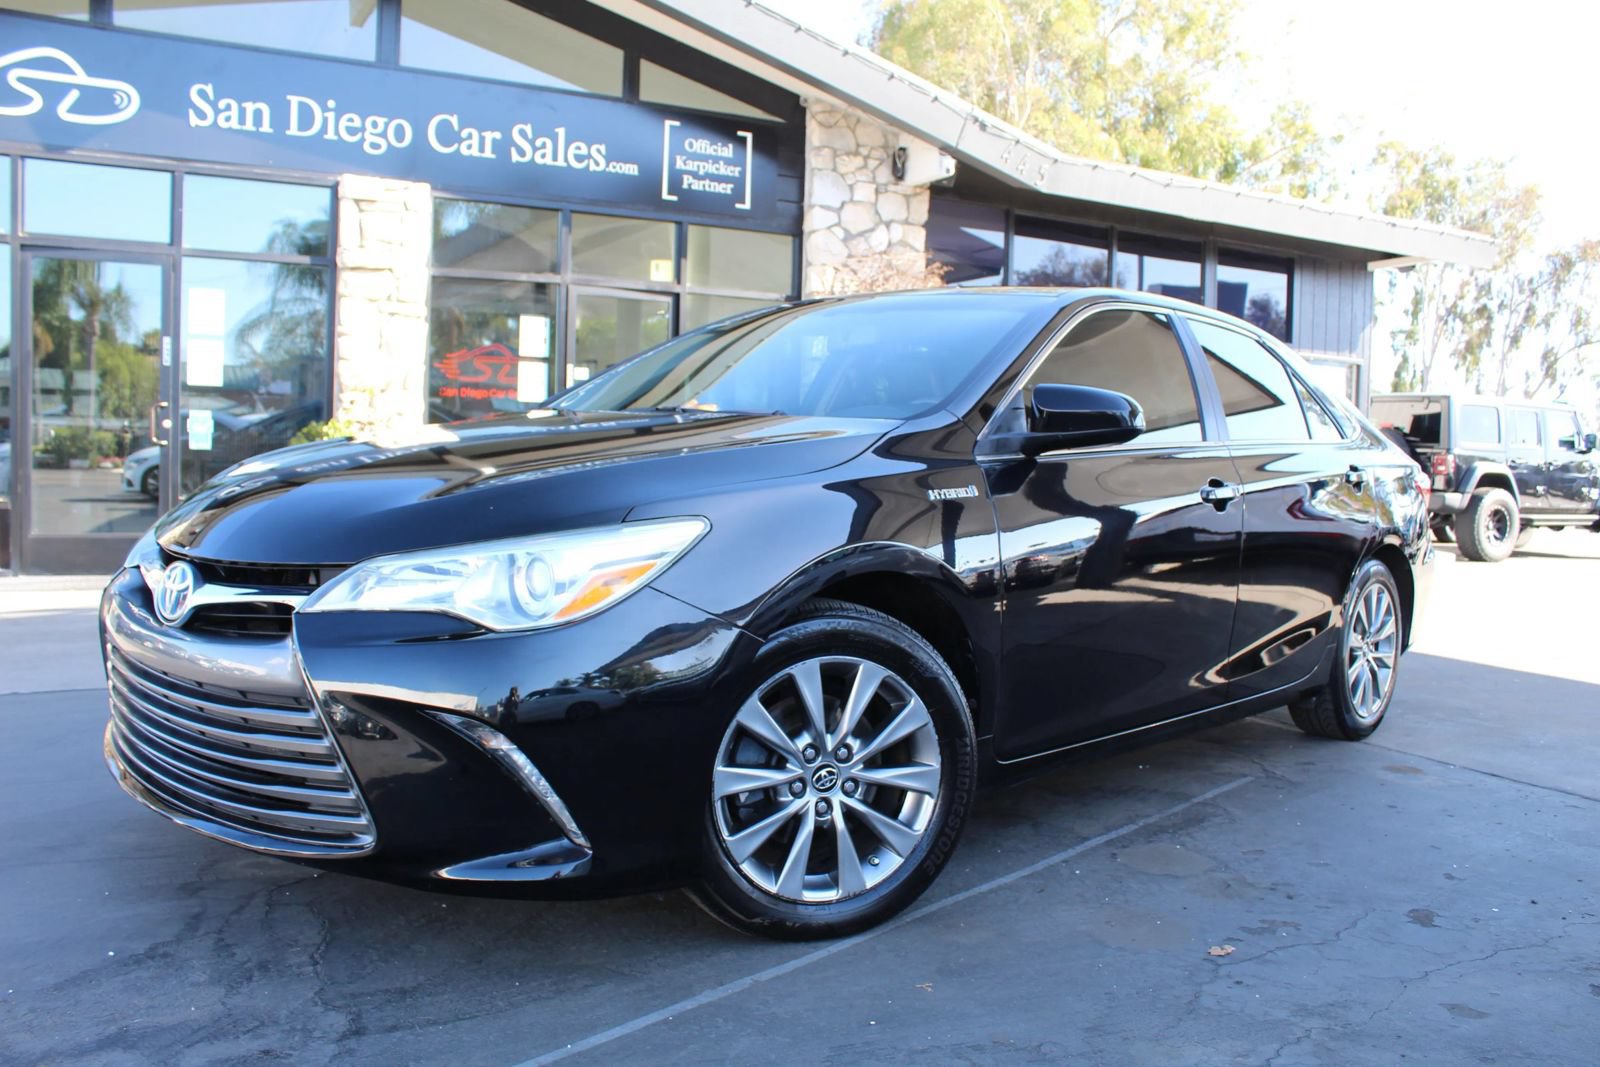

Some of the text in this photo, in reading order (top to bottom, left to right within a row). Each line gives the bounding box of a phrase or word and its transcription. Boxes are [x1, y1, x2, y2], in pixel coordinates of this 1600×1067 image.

[189, 83, 274, 134] San
[285, 95, 413, 155] Diego
[427, 114, 502, 158] Car
[684, 138, 734, 158] Official
[675, 155, 742, 177] Karpicker
[681, 174, 734, 194] Partner
[928, 487, 974, 501] HYBRID
